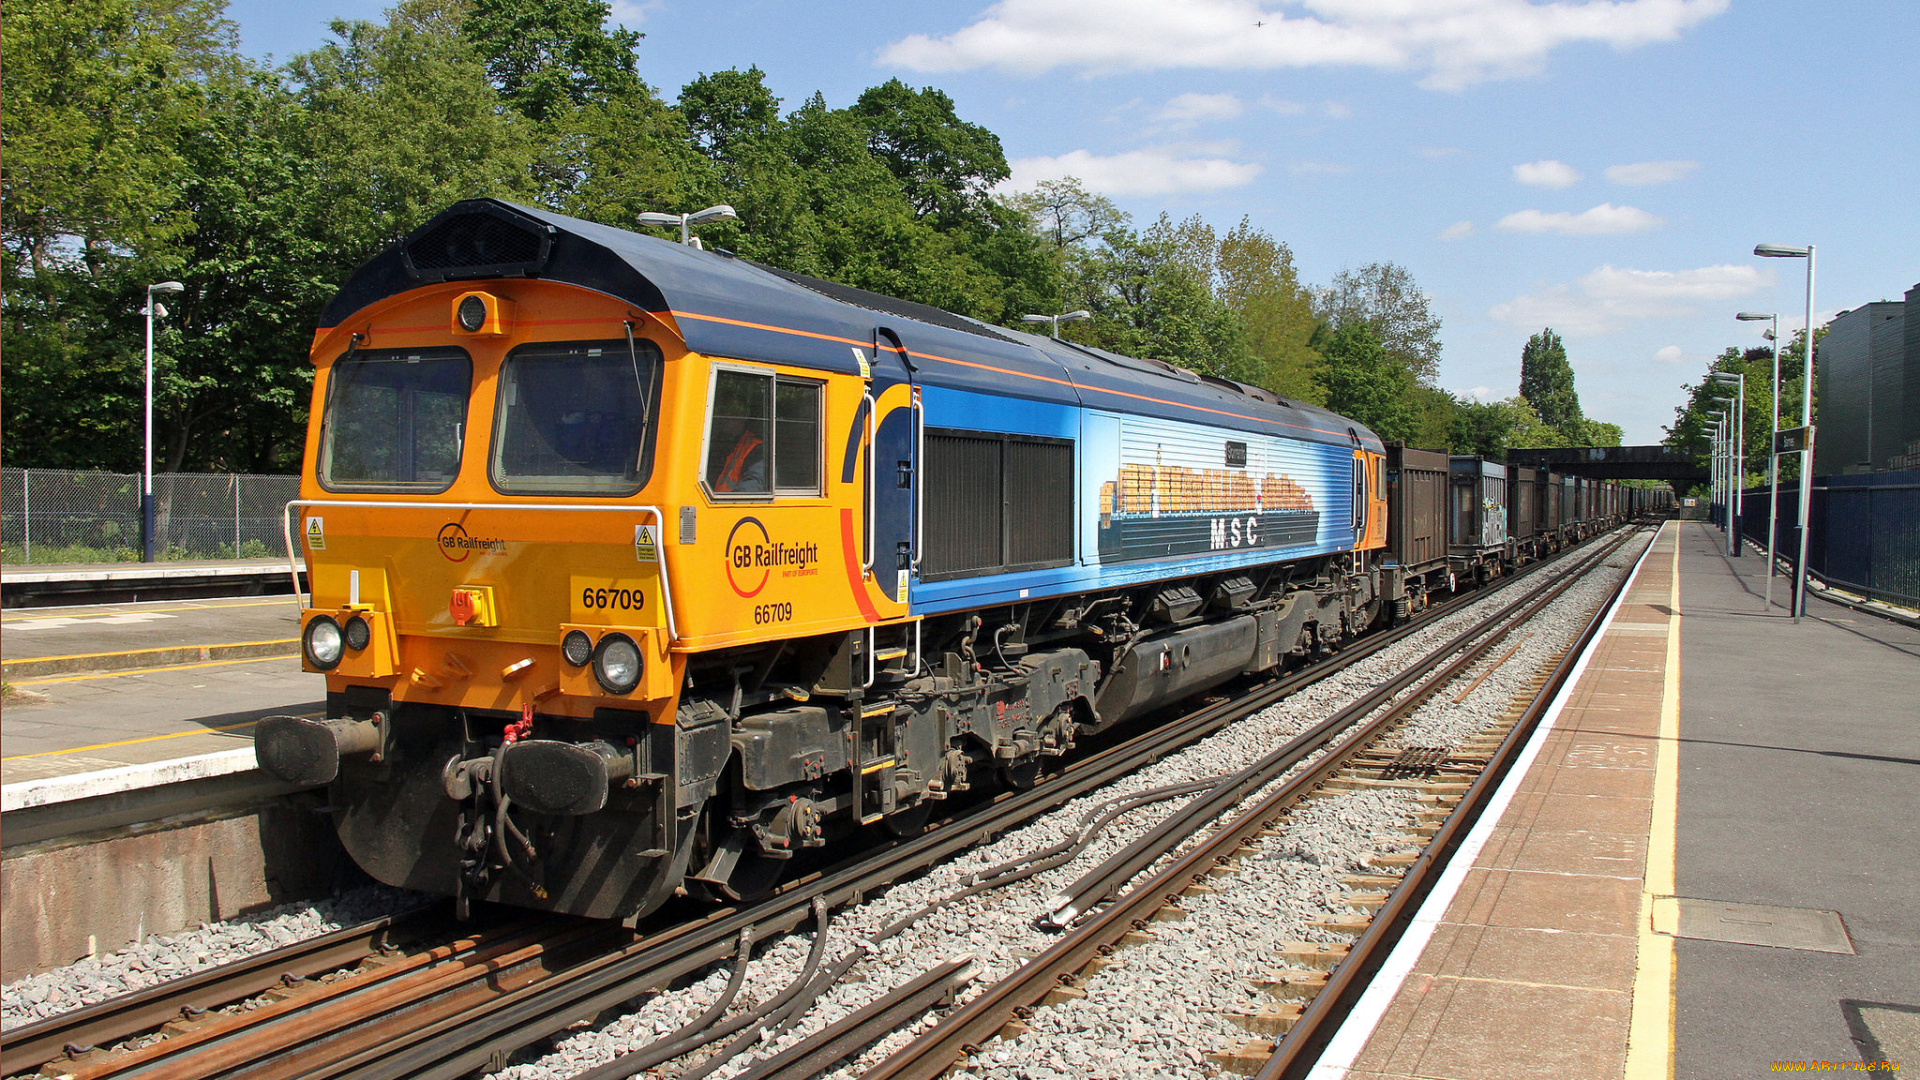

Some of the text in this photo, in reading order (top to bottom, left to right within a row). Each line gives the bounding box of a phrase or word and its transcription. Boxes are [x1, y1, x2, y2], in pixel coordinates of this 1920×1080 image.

[442, 536, 506, 552] GB Railfreight
[1210, 516, 1258, 550] MSC
[733, 541, 818, 570] GB Railfreight
[583, 588, 644, 610] 66709
[754, 602, 792, 625] 66709
